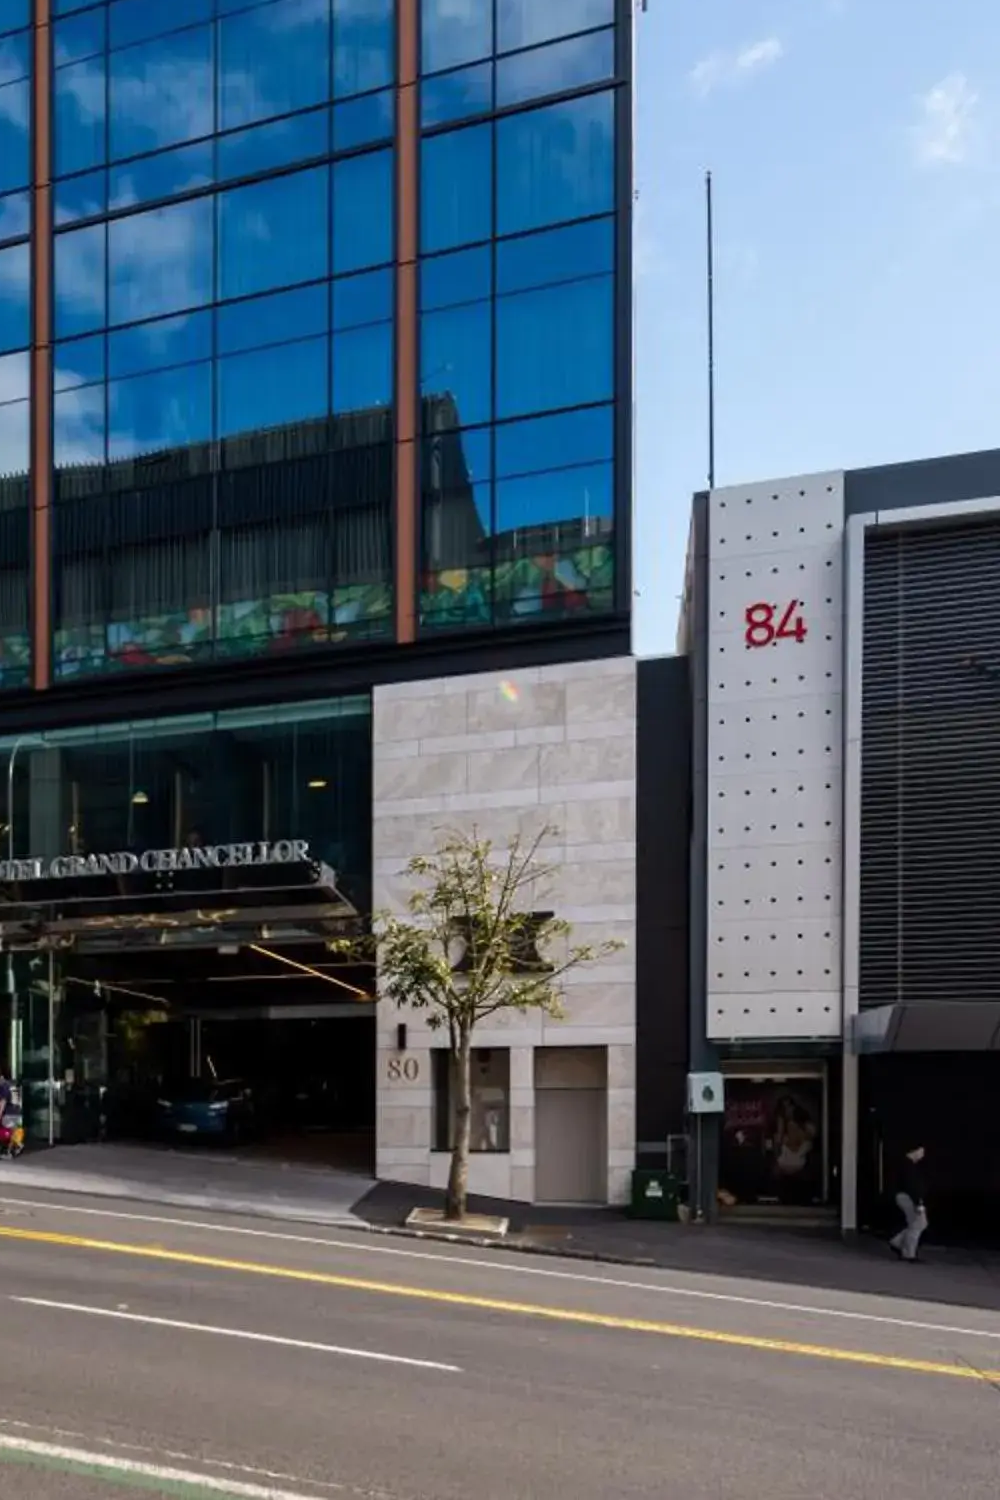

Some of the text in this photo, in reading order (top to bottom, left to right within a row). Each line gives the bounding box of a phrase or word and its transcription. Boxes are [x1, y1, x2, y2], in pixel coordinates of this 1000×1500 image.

[745, 599, 808, 647] 84
[50, 851, 139, 878] GRAND
[140, 839, 313, 872] CHANCELLOR
[387, 1057, 419, 1082] 80
